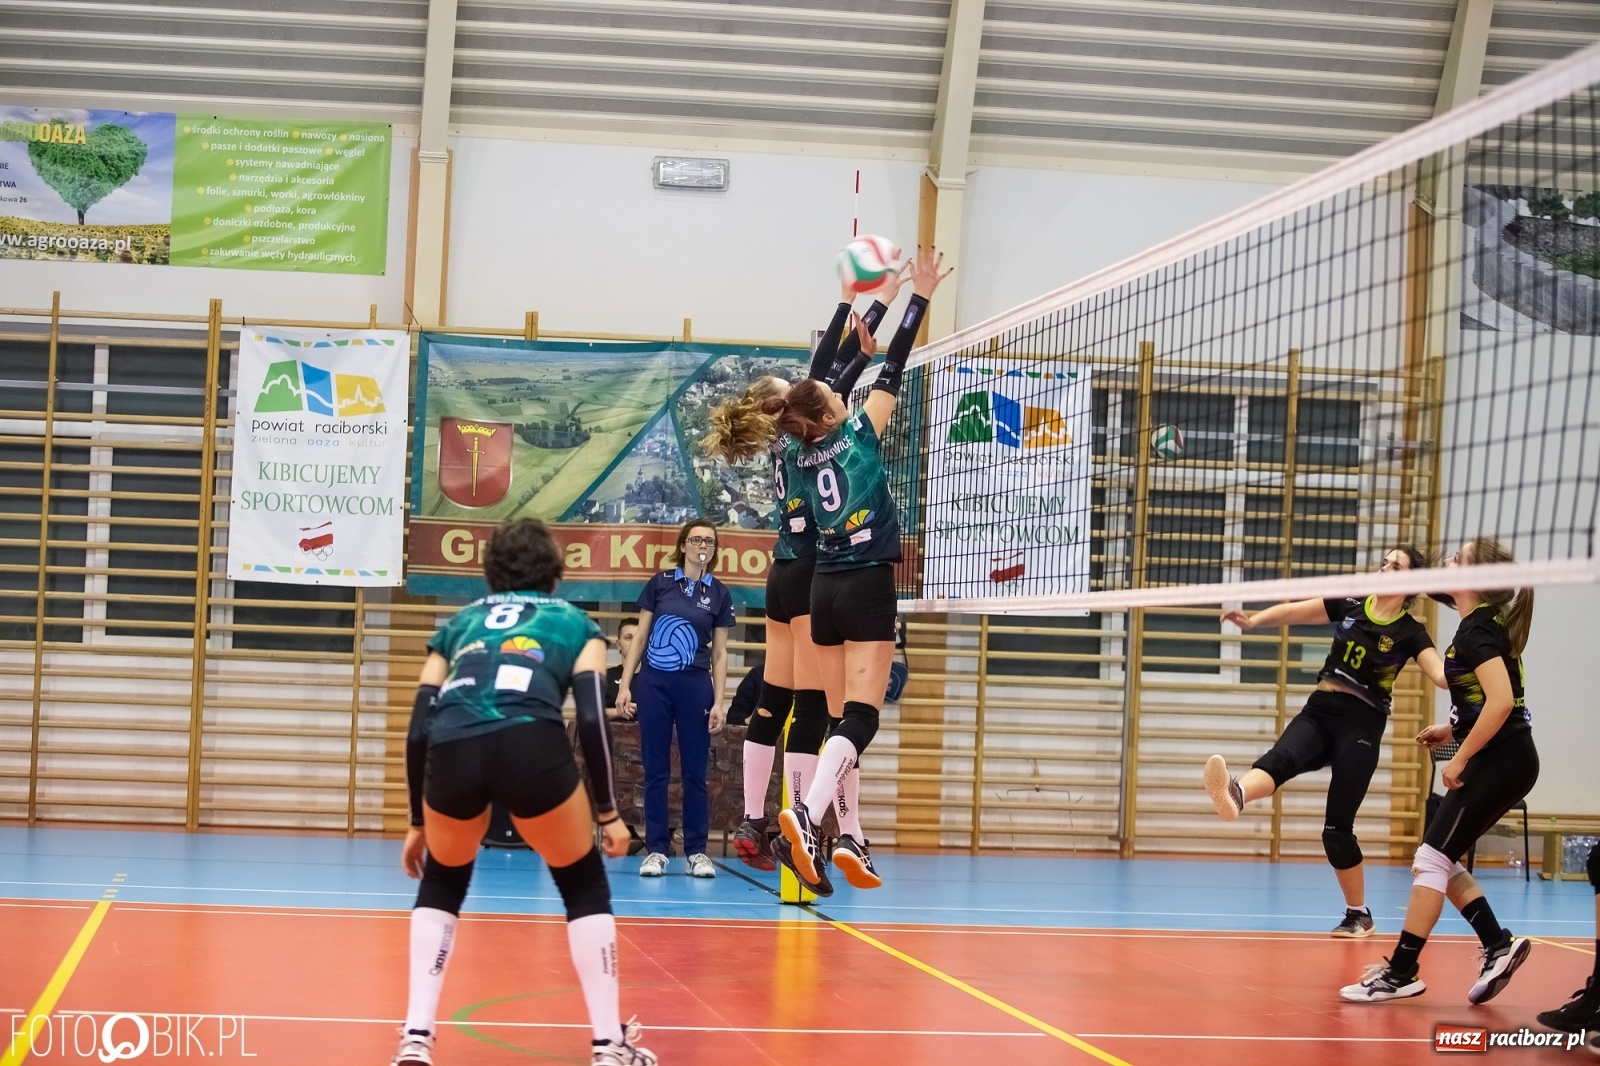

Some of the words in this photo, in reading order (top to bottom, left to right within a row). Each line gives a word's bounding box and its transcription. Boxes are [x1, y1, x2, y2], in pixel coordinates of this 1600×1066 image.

[191, 125, 221, 135] środki
[223, 127, 261, 139] ochrony
[263, 128, 289, 138] roślin
[301, 132, 337, 141] nawozy
[349, 133, 385, 143] nasiona
[211, 143, 237, 153] pasze
[244, 142, 280, 153] dodatki
[282, 146, 323, 157] paszowe
[334, 148, 365, 158] węgiel
[235, 158, 273, 169] systemy
[275, 160, 340, 172] nawadniające
[238, 173, 283, 185] narzędzia
[291, 175, 335, 186] akcesoria
[206, 187, 230, 199] folie,
[232, 188, 268, 200] sznurki,
[271, 190, 300, 202] worki,
[302, 192, 366, 204] agrowłókniny
[254, 205, 294, 216] podłoża,
[296, 206, 317, 215] kora
[213, 217, 251, 227] doniczki
[253, 219, 296, 231] ozdobne,
[299, 222, 356, 233] produkcyjne
[252, 235, 316, 246] pszczelarstwo
[210, 248, 259, 258] zakuwanie
[261, 250, 285, 261] węży
[287, 250, 356, 262] hydraulicznych
[251, 418, 304, 434] powiat
[315, 420, 388, 436] raciborski
[251, 434, 297, 446] zielona
[307, 438, 340, 447] oaza
[349, 438, 388, 448] kultur
[258, 461, 382, 489] KIBICUJEMY
[816, 467, 841, 512] 9
[240, 491, 394, 516] SPORTOWCOM
[950, 492, 1067, 517] KIBICUJEMY
[934, 520, 1080, 545] SPORTOWCOM
[484, 604, 525, 630] 8
[1343, 640, 1367, 669] 13
